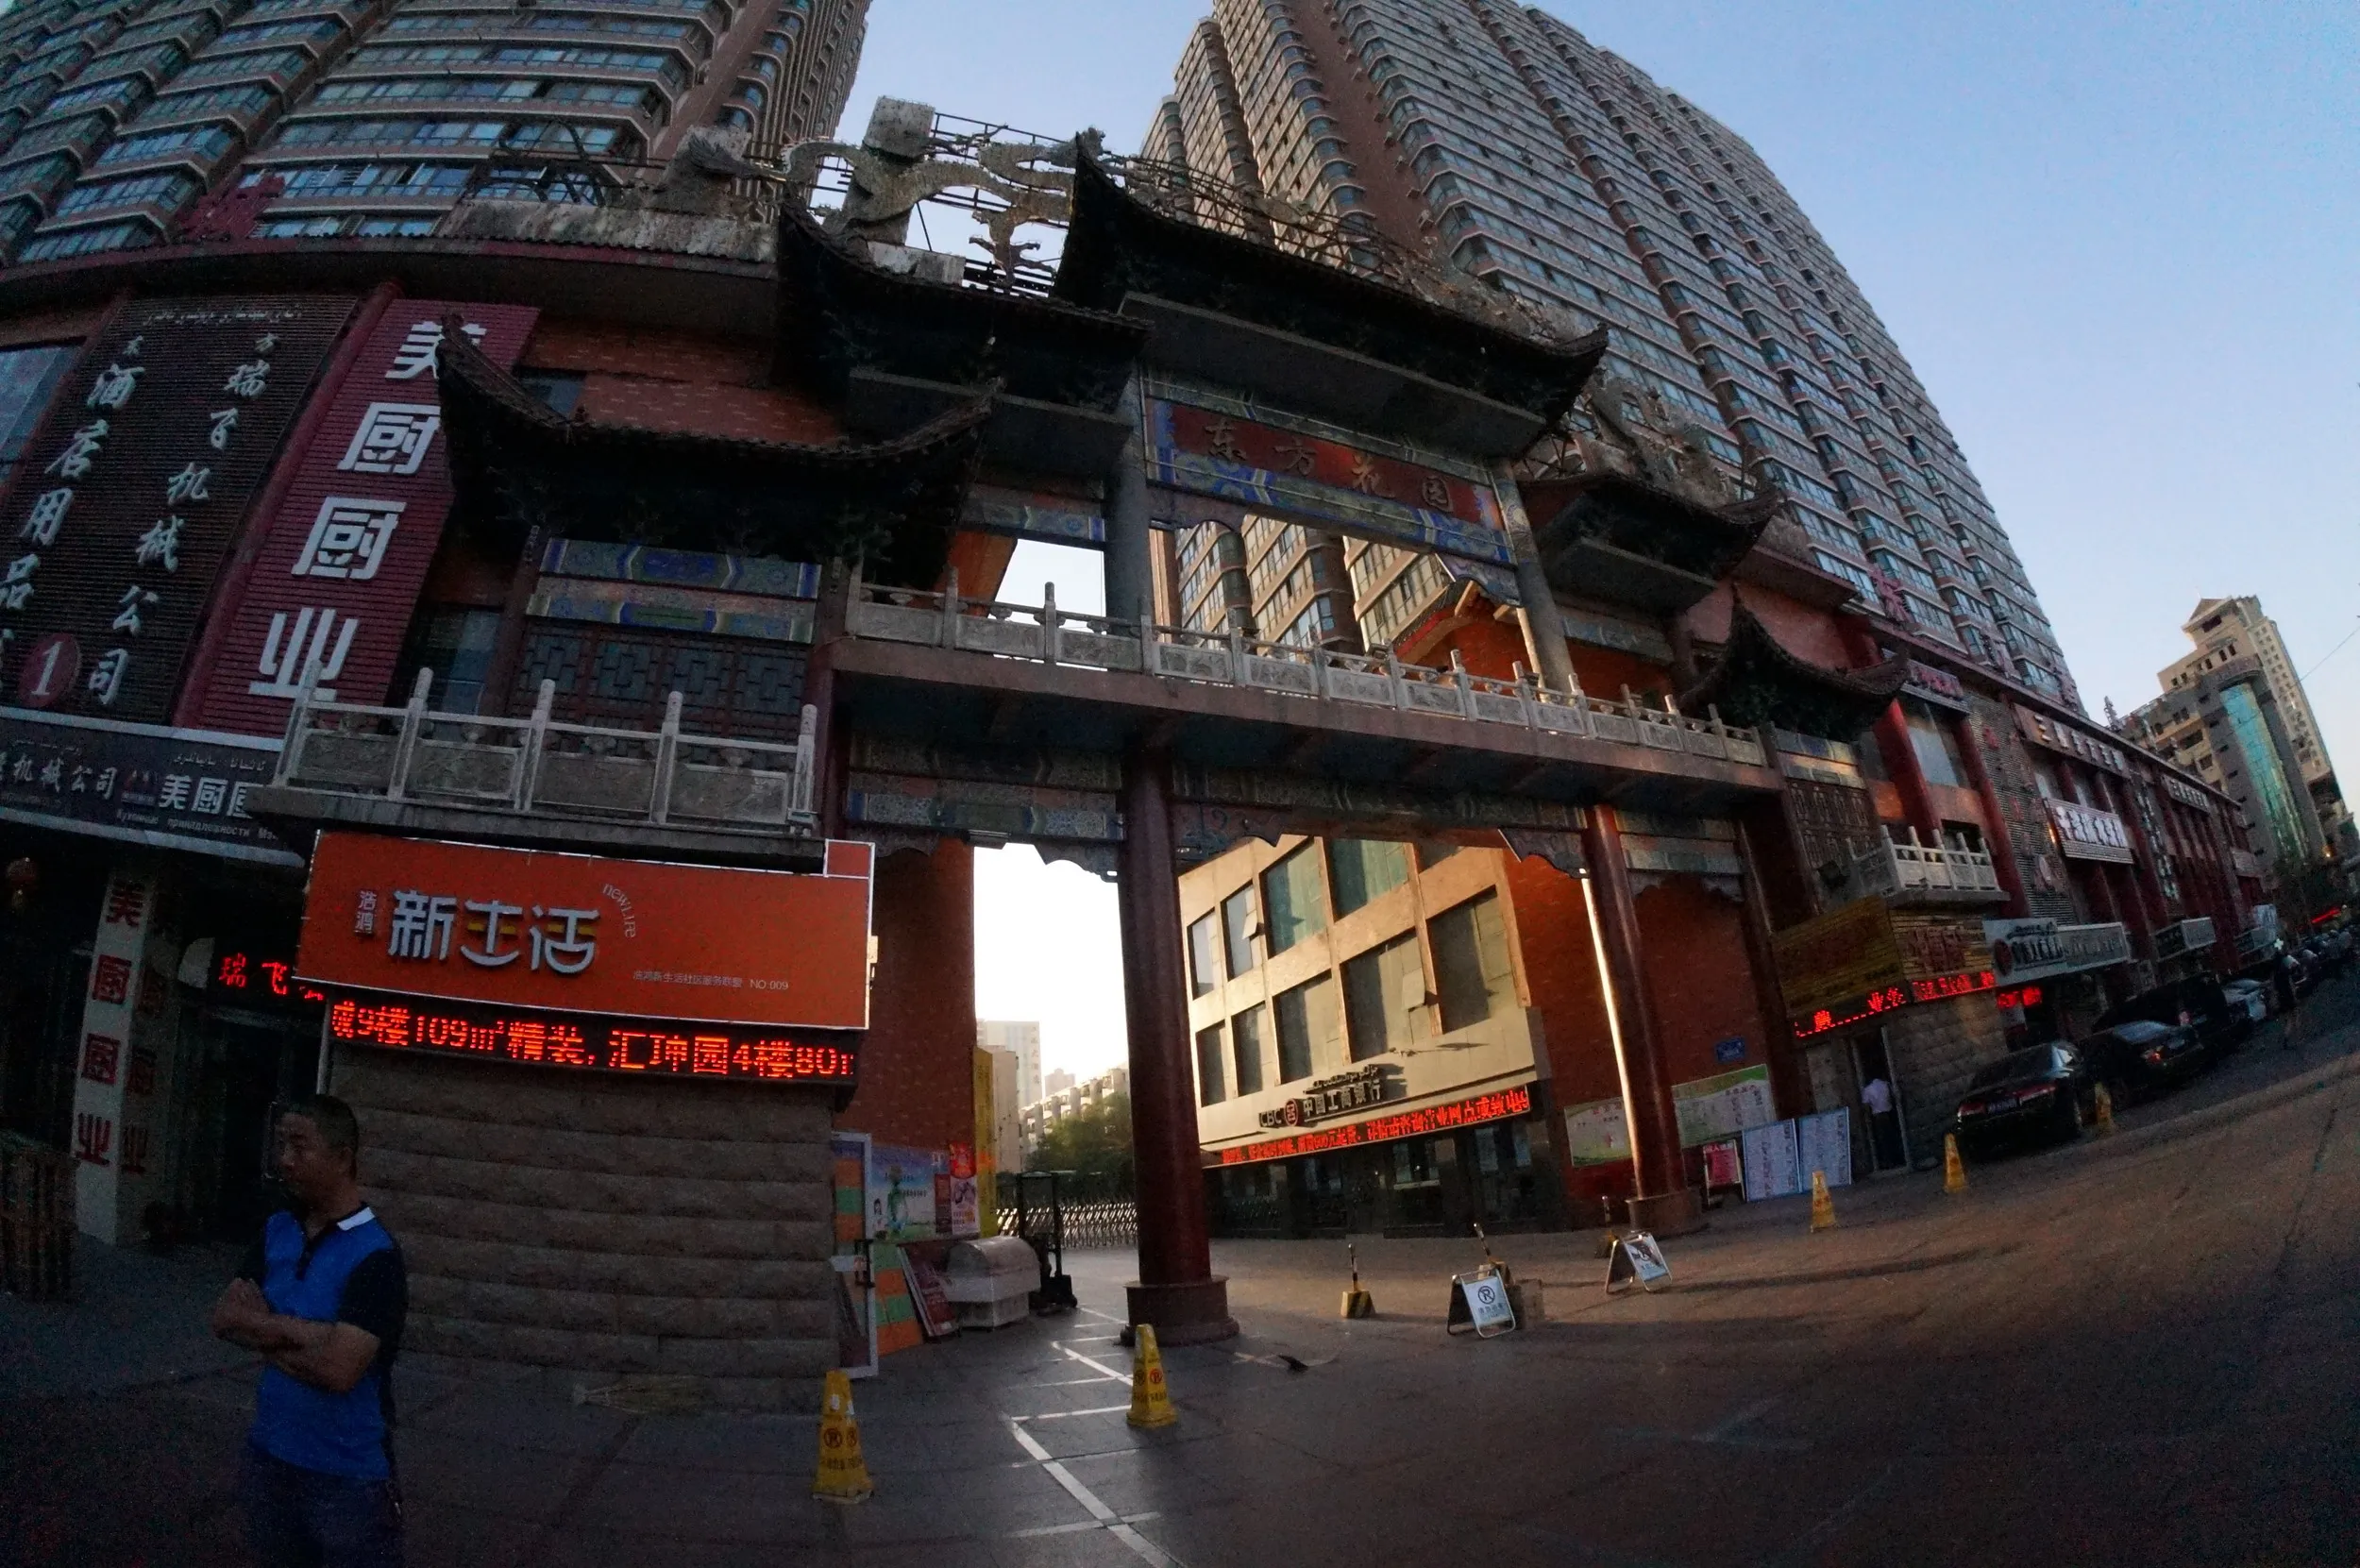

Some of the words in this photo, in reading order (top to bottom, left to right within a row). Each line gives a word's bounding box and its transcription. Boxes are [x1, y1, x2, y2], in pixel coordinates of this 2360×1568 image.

[31, 641, 63, 697] 1
[0, 751, 118, 801] 机械公司
[387, 890, 601, 975] 新生活
[1303, 1077, 1381, 1118] 中国工商银行
